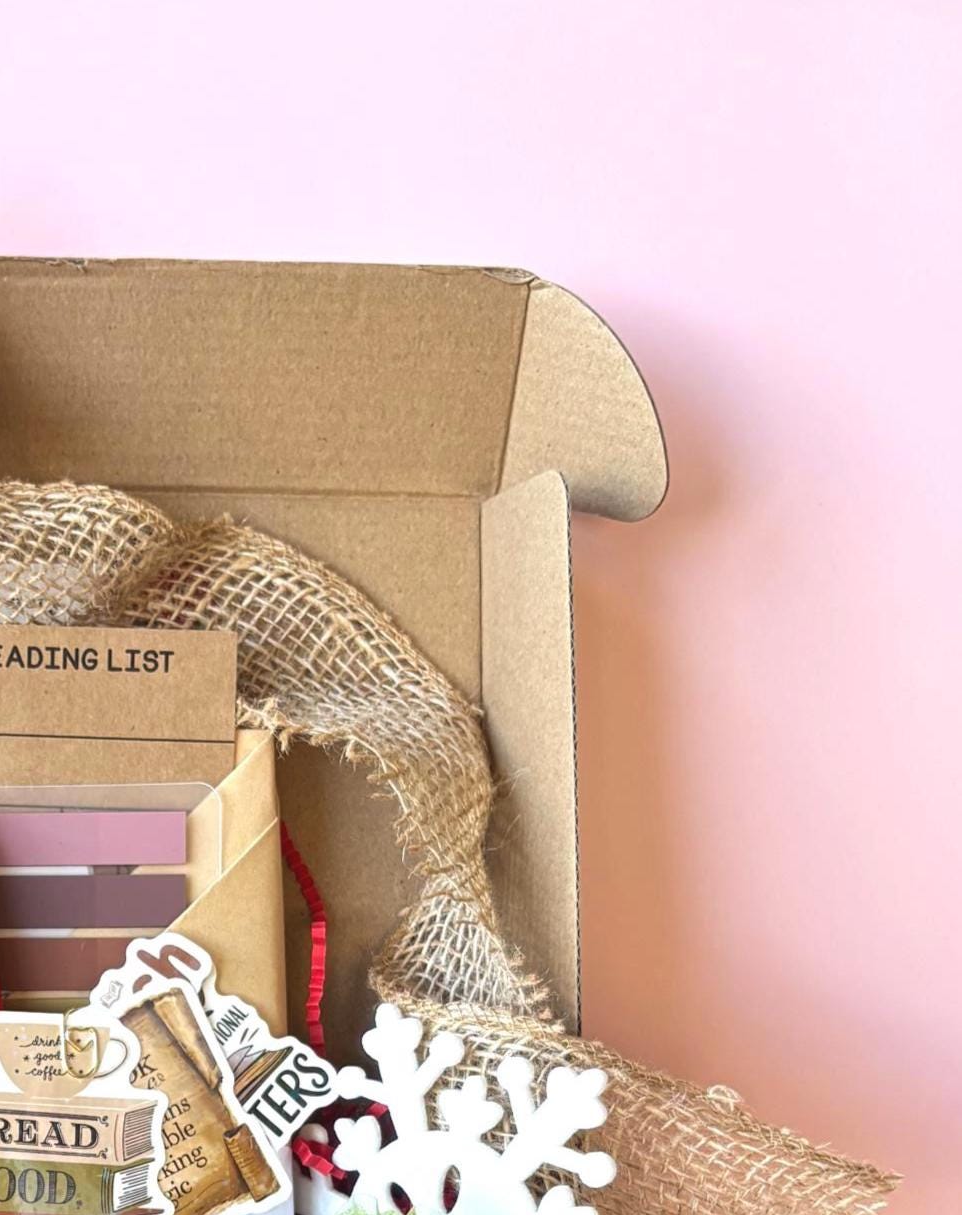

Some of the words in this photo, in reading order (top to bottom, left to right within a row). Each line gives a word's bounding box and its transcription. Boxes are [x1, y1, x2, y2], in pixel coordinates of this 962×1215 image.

[106, 649, 175, 674] LIST
[33, 1050, 63, 1066] good
[25, 1065, 68, 1081] coffee
[160, 1120, 196, 1150] ble
[157, 1145, 208, 1182] king
